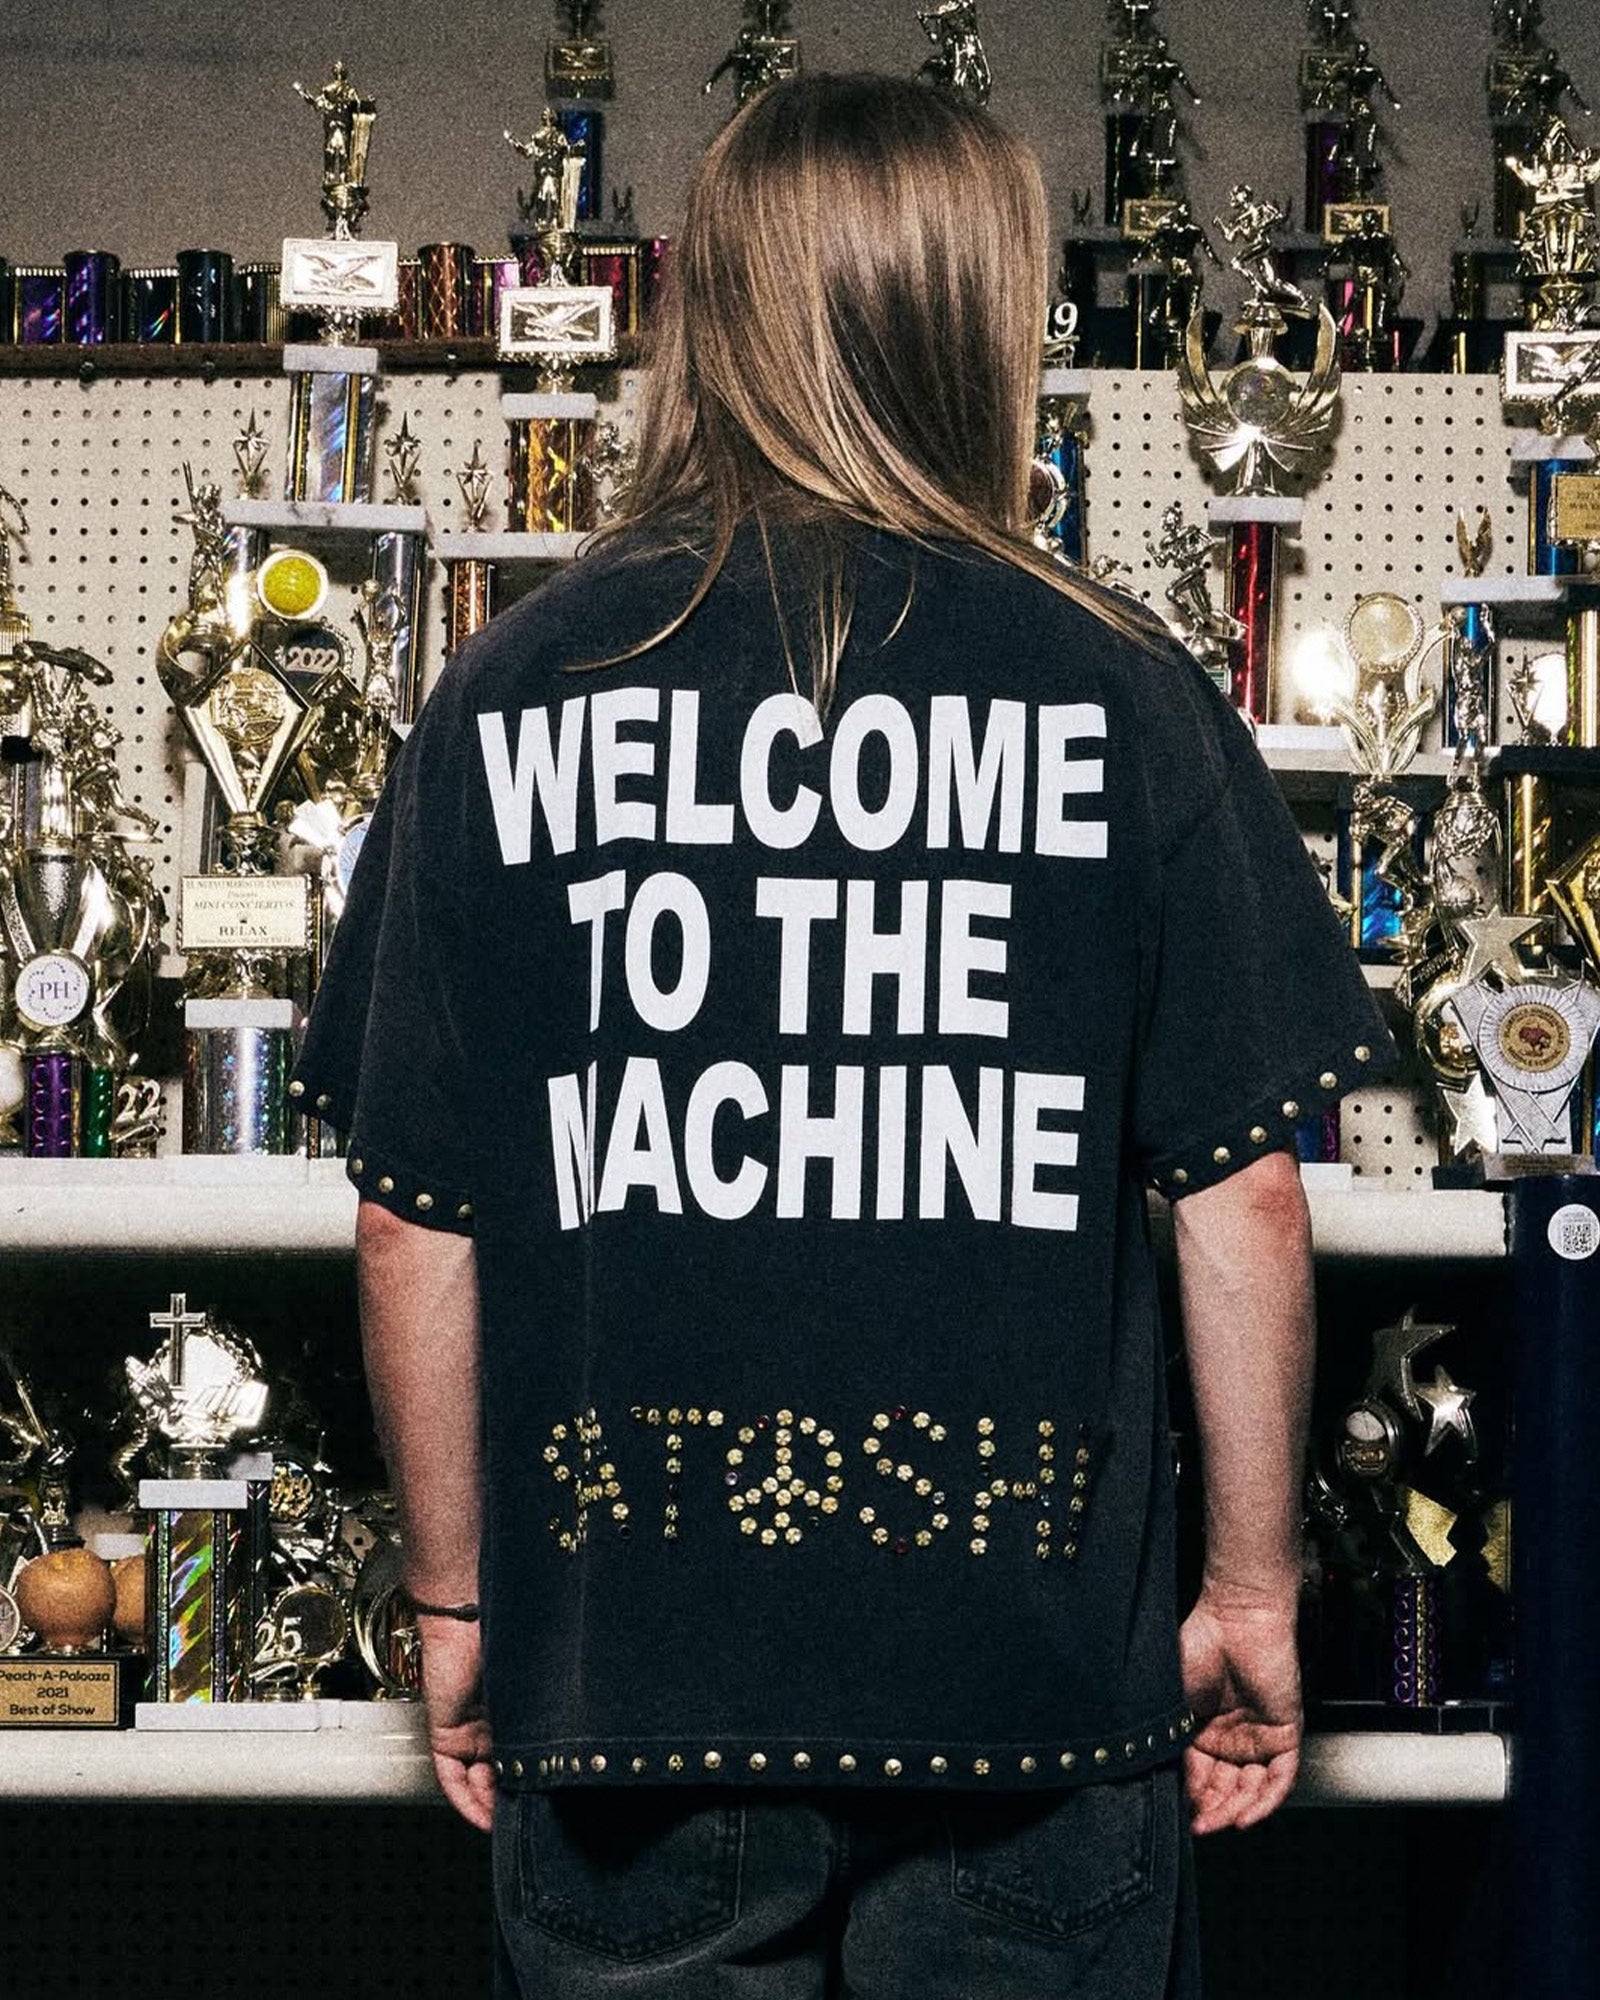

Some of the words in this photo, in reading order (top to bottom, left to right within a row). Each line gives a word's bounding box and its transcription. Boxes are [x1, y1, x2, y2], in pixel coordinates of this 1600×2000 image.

[286, 645, 340, 675] 2022
[477, 686, 1108, 866] WELCOME
[219, 926, 267, 936] RELAX
[567, 869, 711, 1033] TO
[755, 877, 1012, 1039] THE
[39, 981, 69, 1000] PH
[116, 1079, 161, 1122] 22
[547, 1056, 1086, 1232] MACHINE
[253, 1616, 304, 1661] 25
[0, 1670, 110, 1681] Peach-A-Palooza
[36, 1687, 69, 1698] 2021
[10, 1704, 39, 1715] Best
[42, 1704, 56, 1715] of
[58, 1704, 95, 1715] Show
